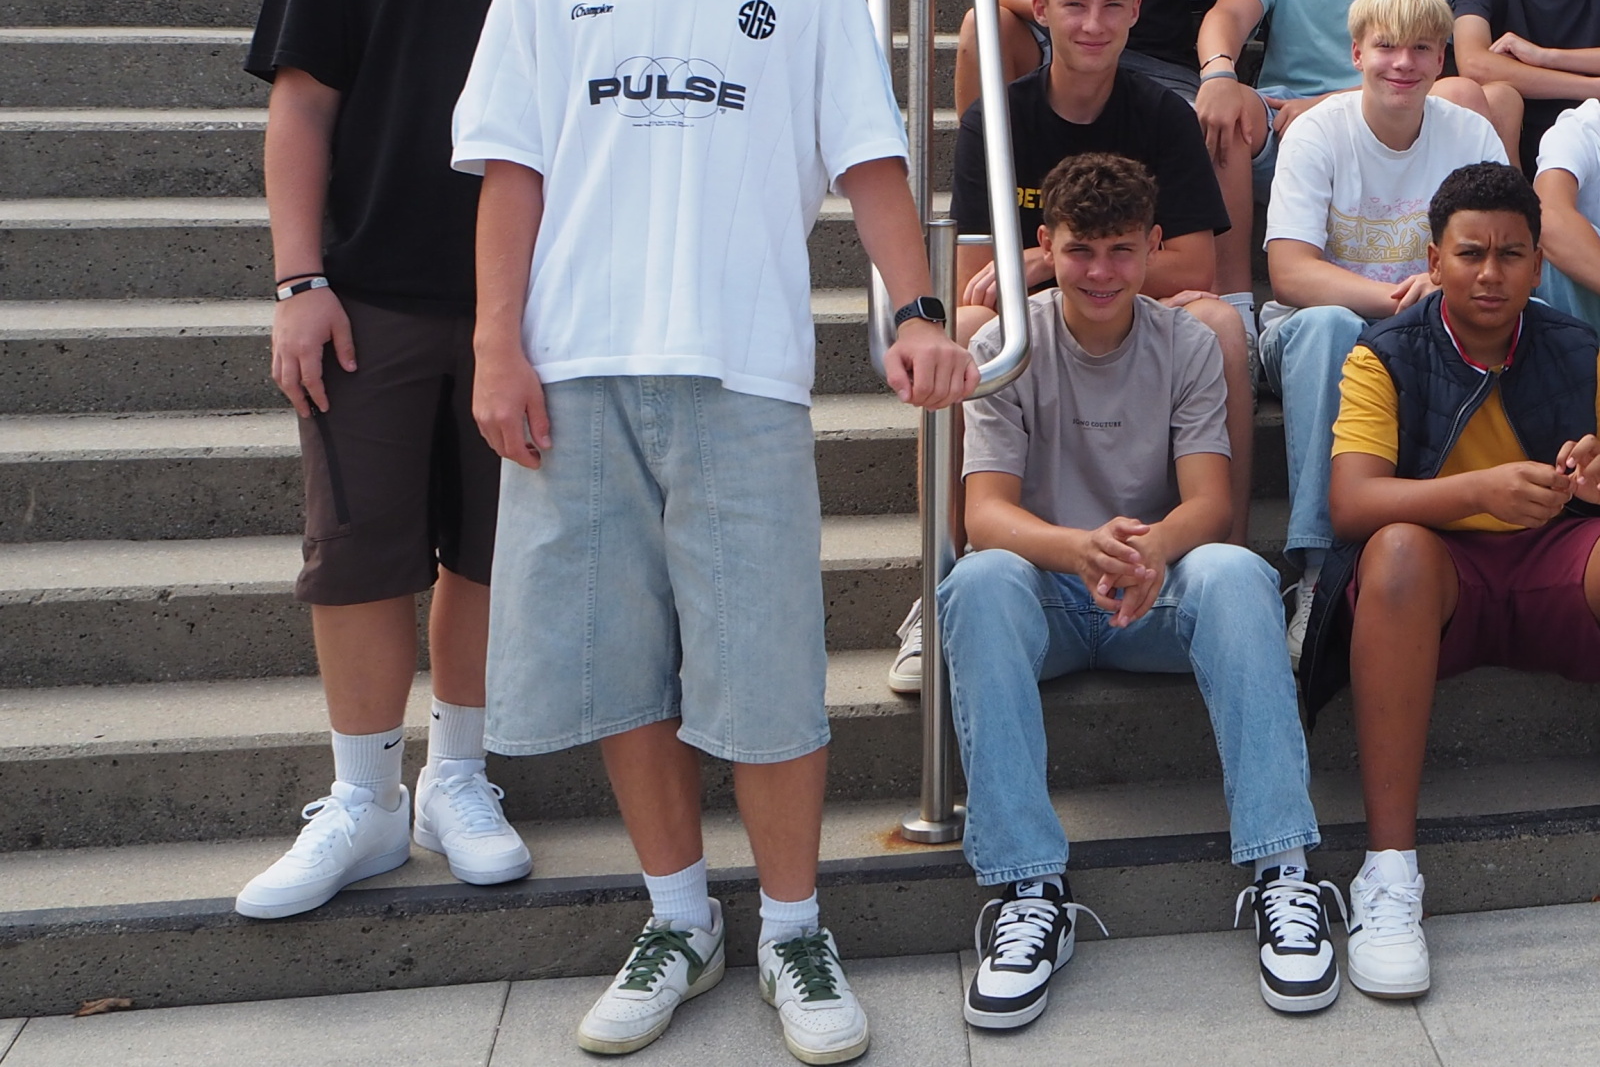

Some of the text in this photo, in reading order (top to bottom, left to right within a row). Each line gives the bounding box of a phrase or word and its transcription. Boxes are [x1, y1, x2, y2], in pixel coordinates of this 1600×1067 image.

[571, 3, 614, 20] Champion
[738, 0, 776, 40] SGS
[588, 74, 746, 111] PULSE
